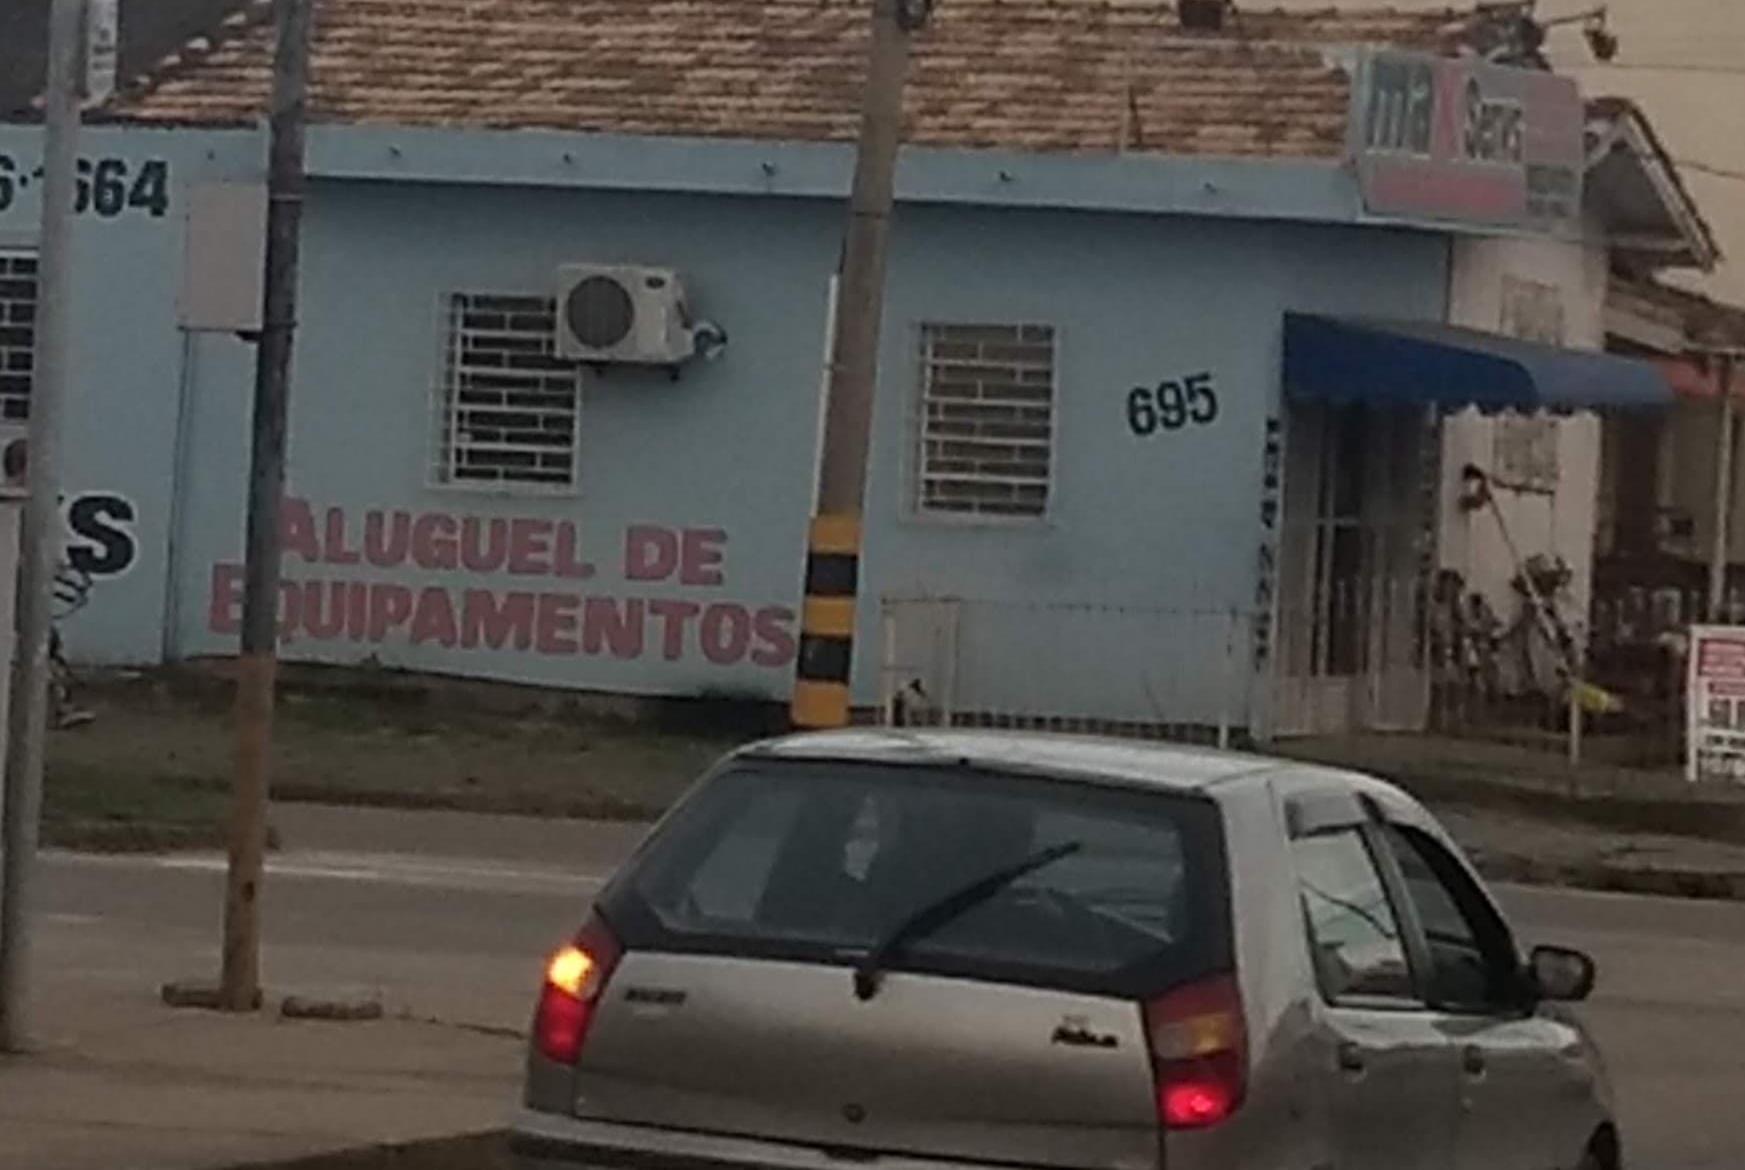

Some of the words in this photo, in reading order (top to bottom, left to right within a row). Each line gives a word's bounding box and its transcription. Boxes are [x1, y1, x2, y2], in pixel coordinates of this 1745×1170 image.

[1127, 371, 1217, 436] 695
[279, 497, 596, 578] ALUGUEL
[624, 524, 727, 586] DE
